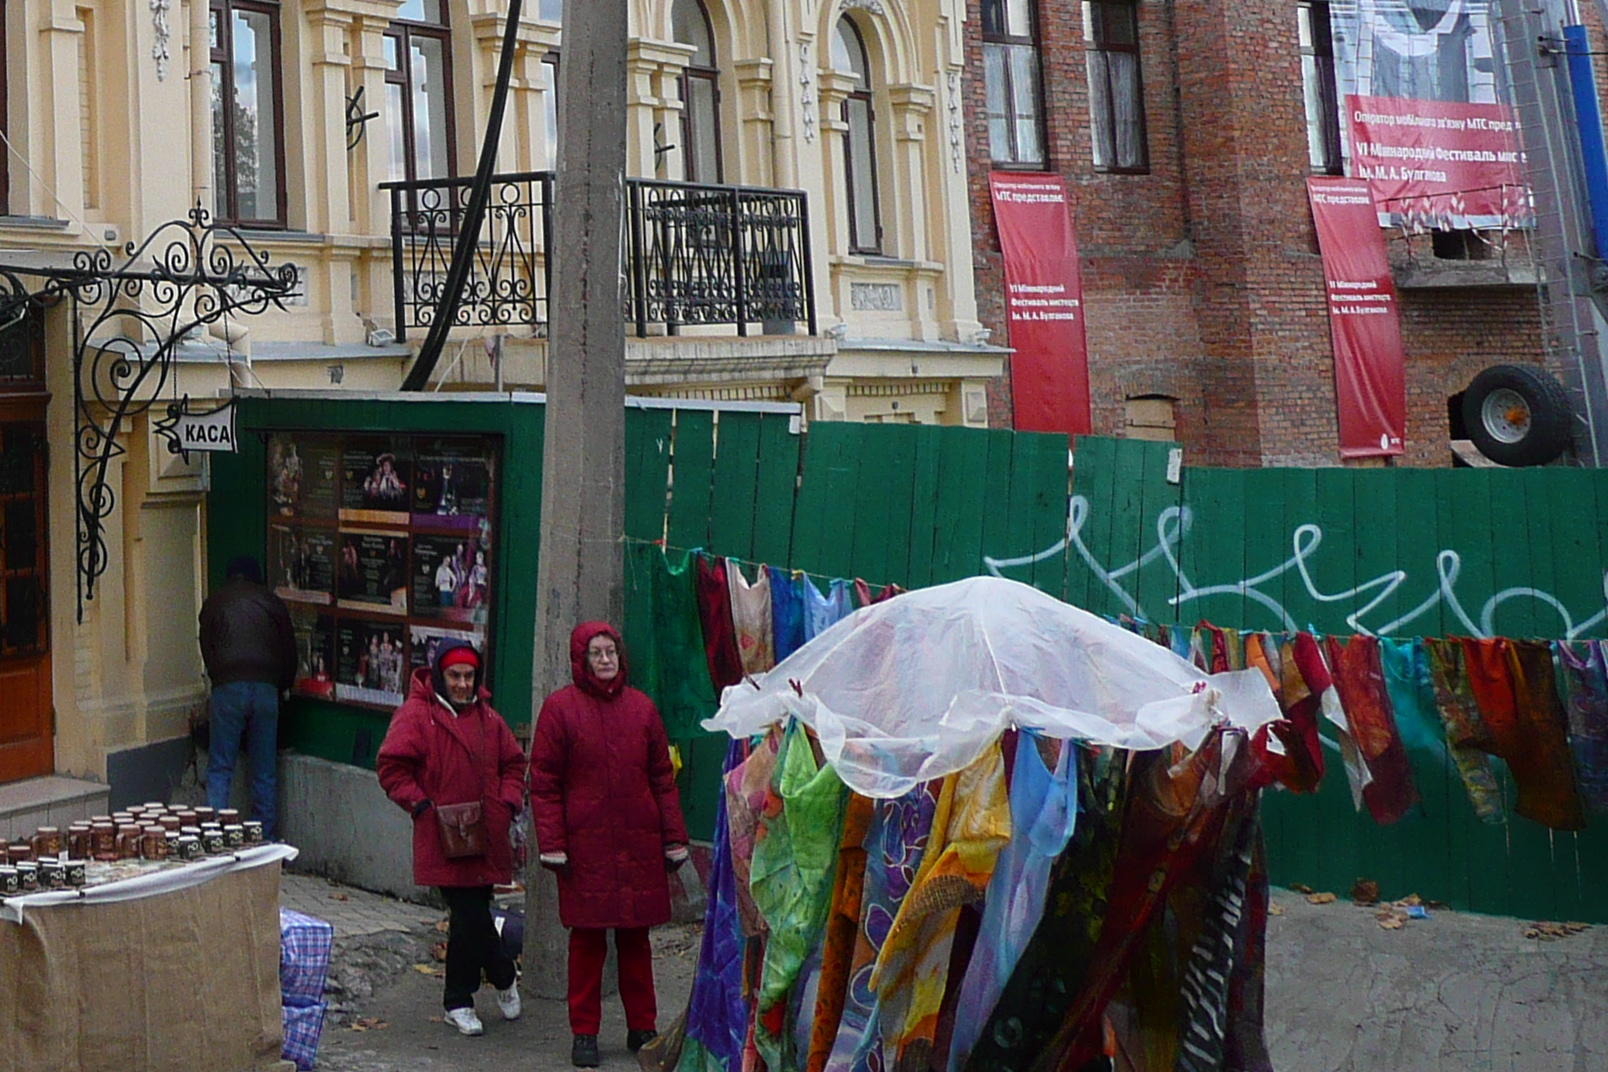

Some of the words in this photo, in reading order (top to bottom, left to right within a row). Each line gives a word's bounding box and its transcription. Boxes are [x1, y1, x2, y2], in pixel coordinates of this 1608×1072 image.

[1467, 118, 1487, 130] МТС
[1435, 147, 1496, 162] Фестиваль
[185, 424, 231, 443] КАСА
